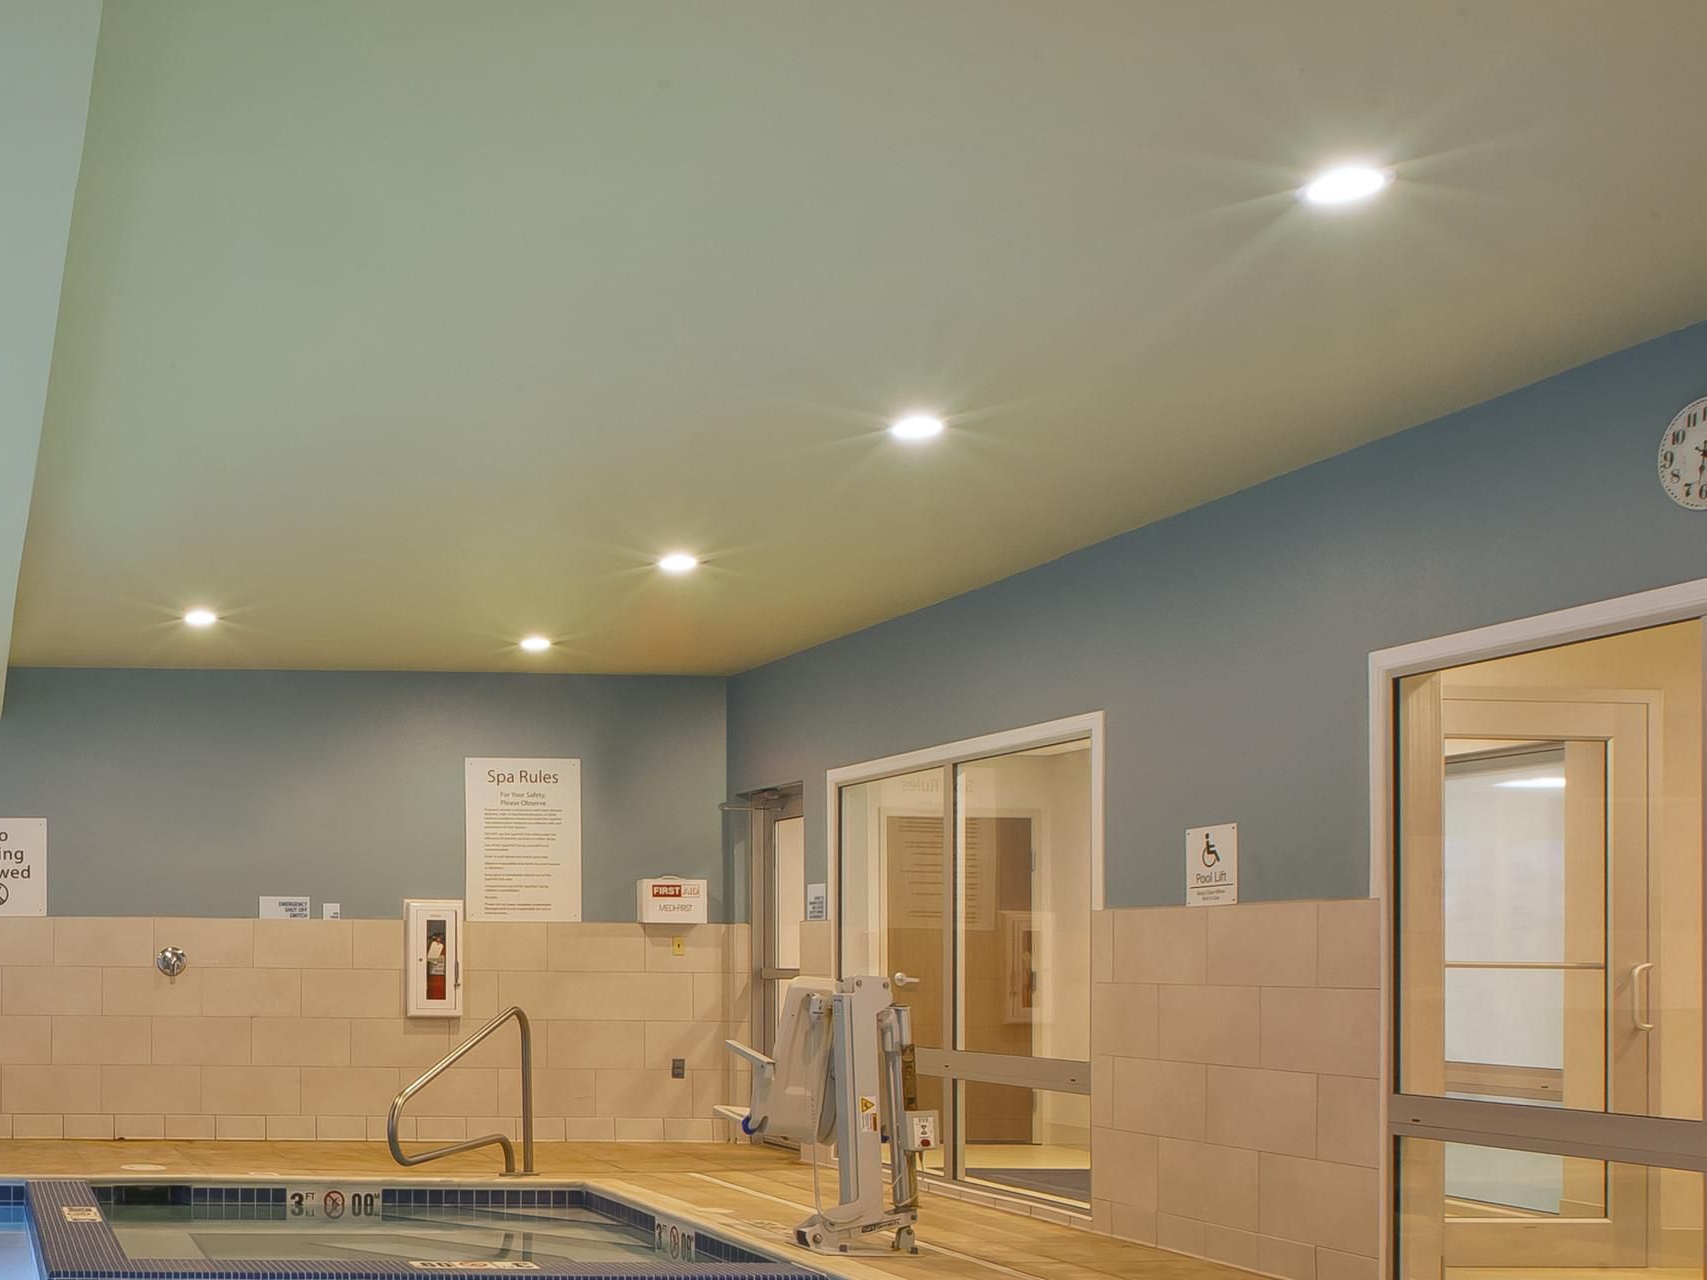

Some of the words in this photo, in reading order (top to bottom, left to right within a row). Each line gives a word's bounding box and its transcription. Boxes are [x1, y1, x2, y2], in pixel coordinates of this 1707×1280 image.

[1687, 413, 1697, 428] 11
[1672, 429, 1686, 445] 10
[1663, 450, 1674, 469] 9
[1671, 469, 1681, 484] 8
[1684, 482, 1694, 497] 7
[1699, 484, 1707, 500] 6
[487, 769, 514, 786] Spa
[519, 769, 559, 784] Rules
[1196, 872, 1213, 884] Pool
[1214, 870, 1227, 883] Lift
[653, 886, 680, 895] FIRST
[682, 887, 699, 895] AID
[290, 1192, 304, 1206] 3
[305, 1192, 315, 1200] FT
